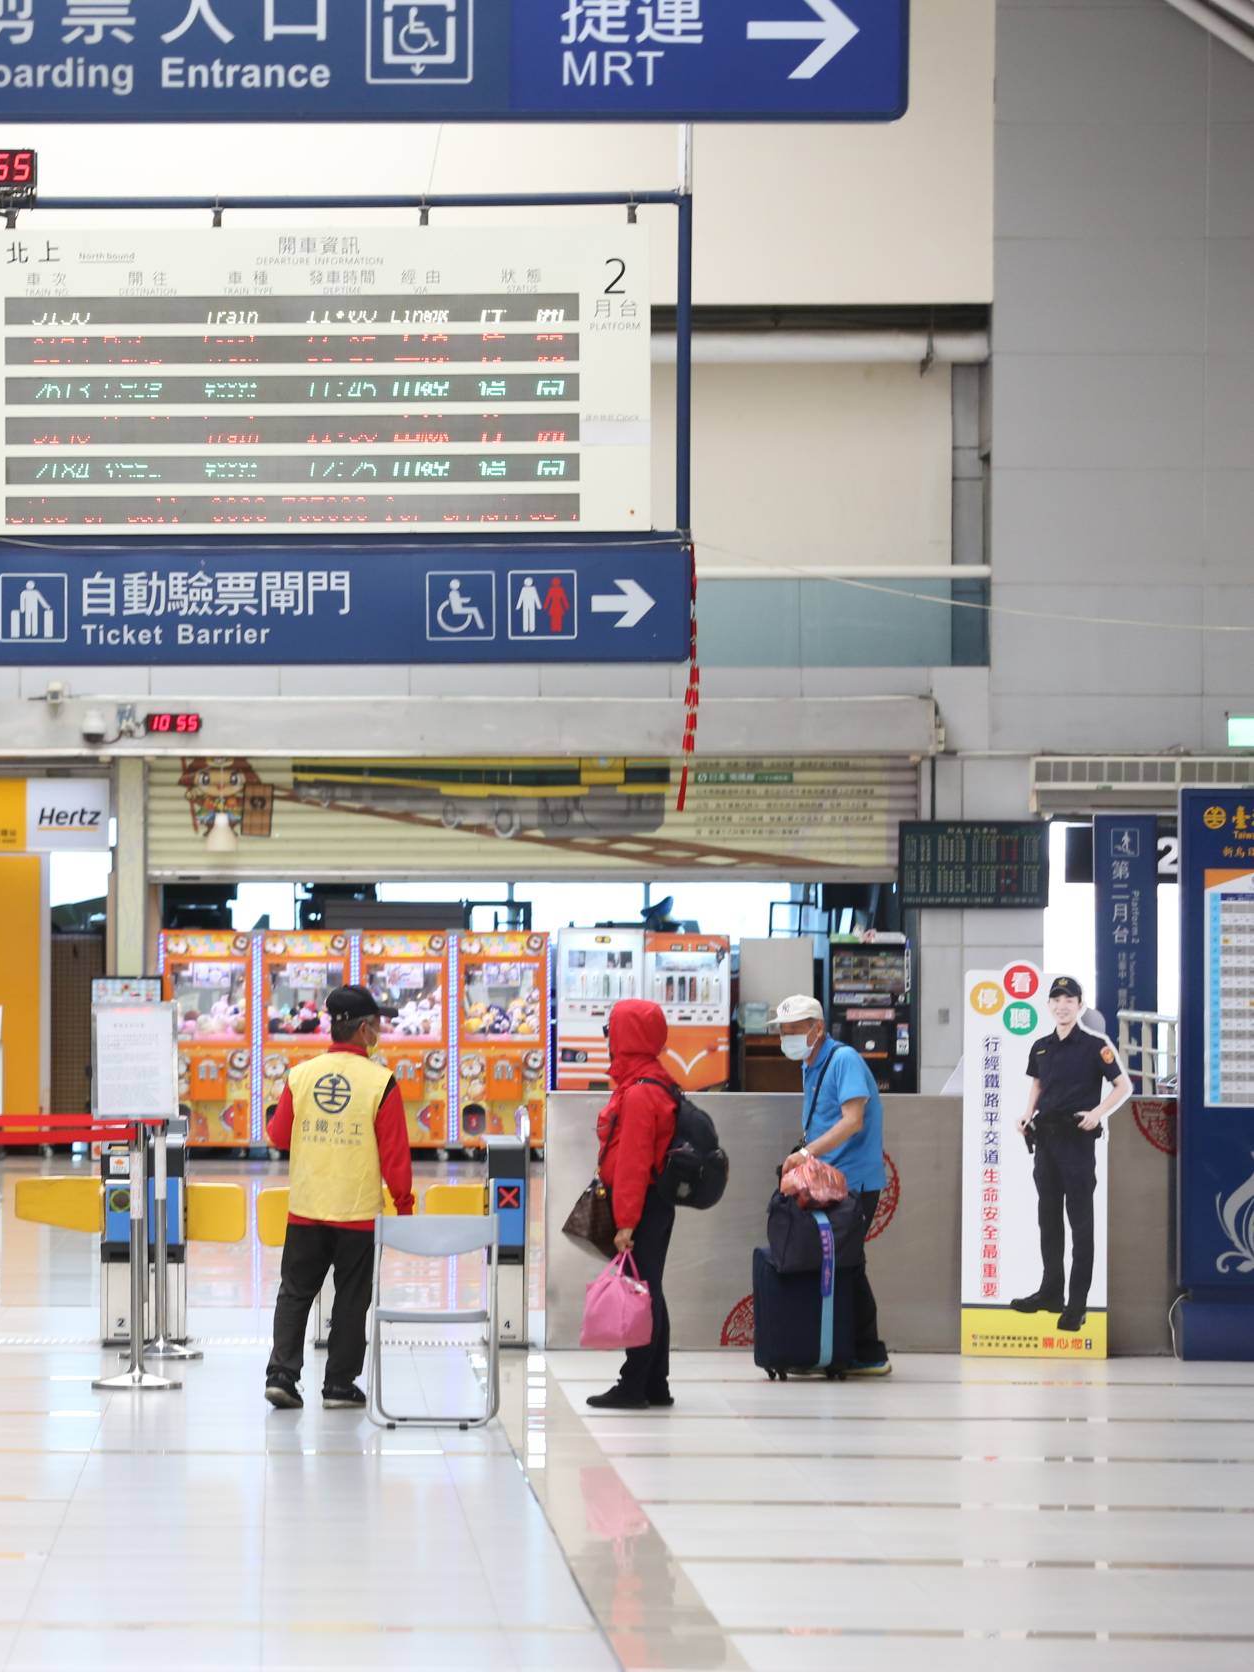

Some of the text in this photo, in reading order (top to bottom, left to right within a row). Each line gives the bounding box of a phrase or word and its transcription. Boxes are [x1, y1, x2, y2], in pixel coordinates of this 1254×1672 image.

[161, 57, 331, 89] Entrance
[561, 51, 665, 87] MRT
[6, 240, 60, 264] 北上
[278, 236, 360, 255] 開車資訊
[26, 271, 67, 286] 車次
[128, 271, 168, 286] 開往
[228, 271, 268, 285] 車種
[604, 258, 626, 294] 2
[593, 300, 638, 319] 月台
[589, 320, 642, 331] PLATFORM
[81, 569, 352, 617] 自動驗票閘門
[81, 623, 271, 646] Ticket Barrier
[153, 714, 171, 731] 10
[37, 806, 102, 827] Hertz
[1157, 836, 1179, 874] 2
[1111, 860, 1130, 944] 第二月台
